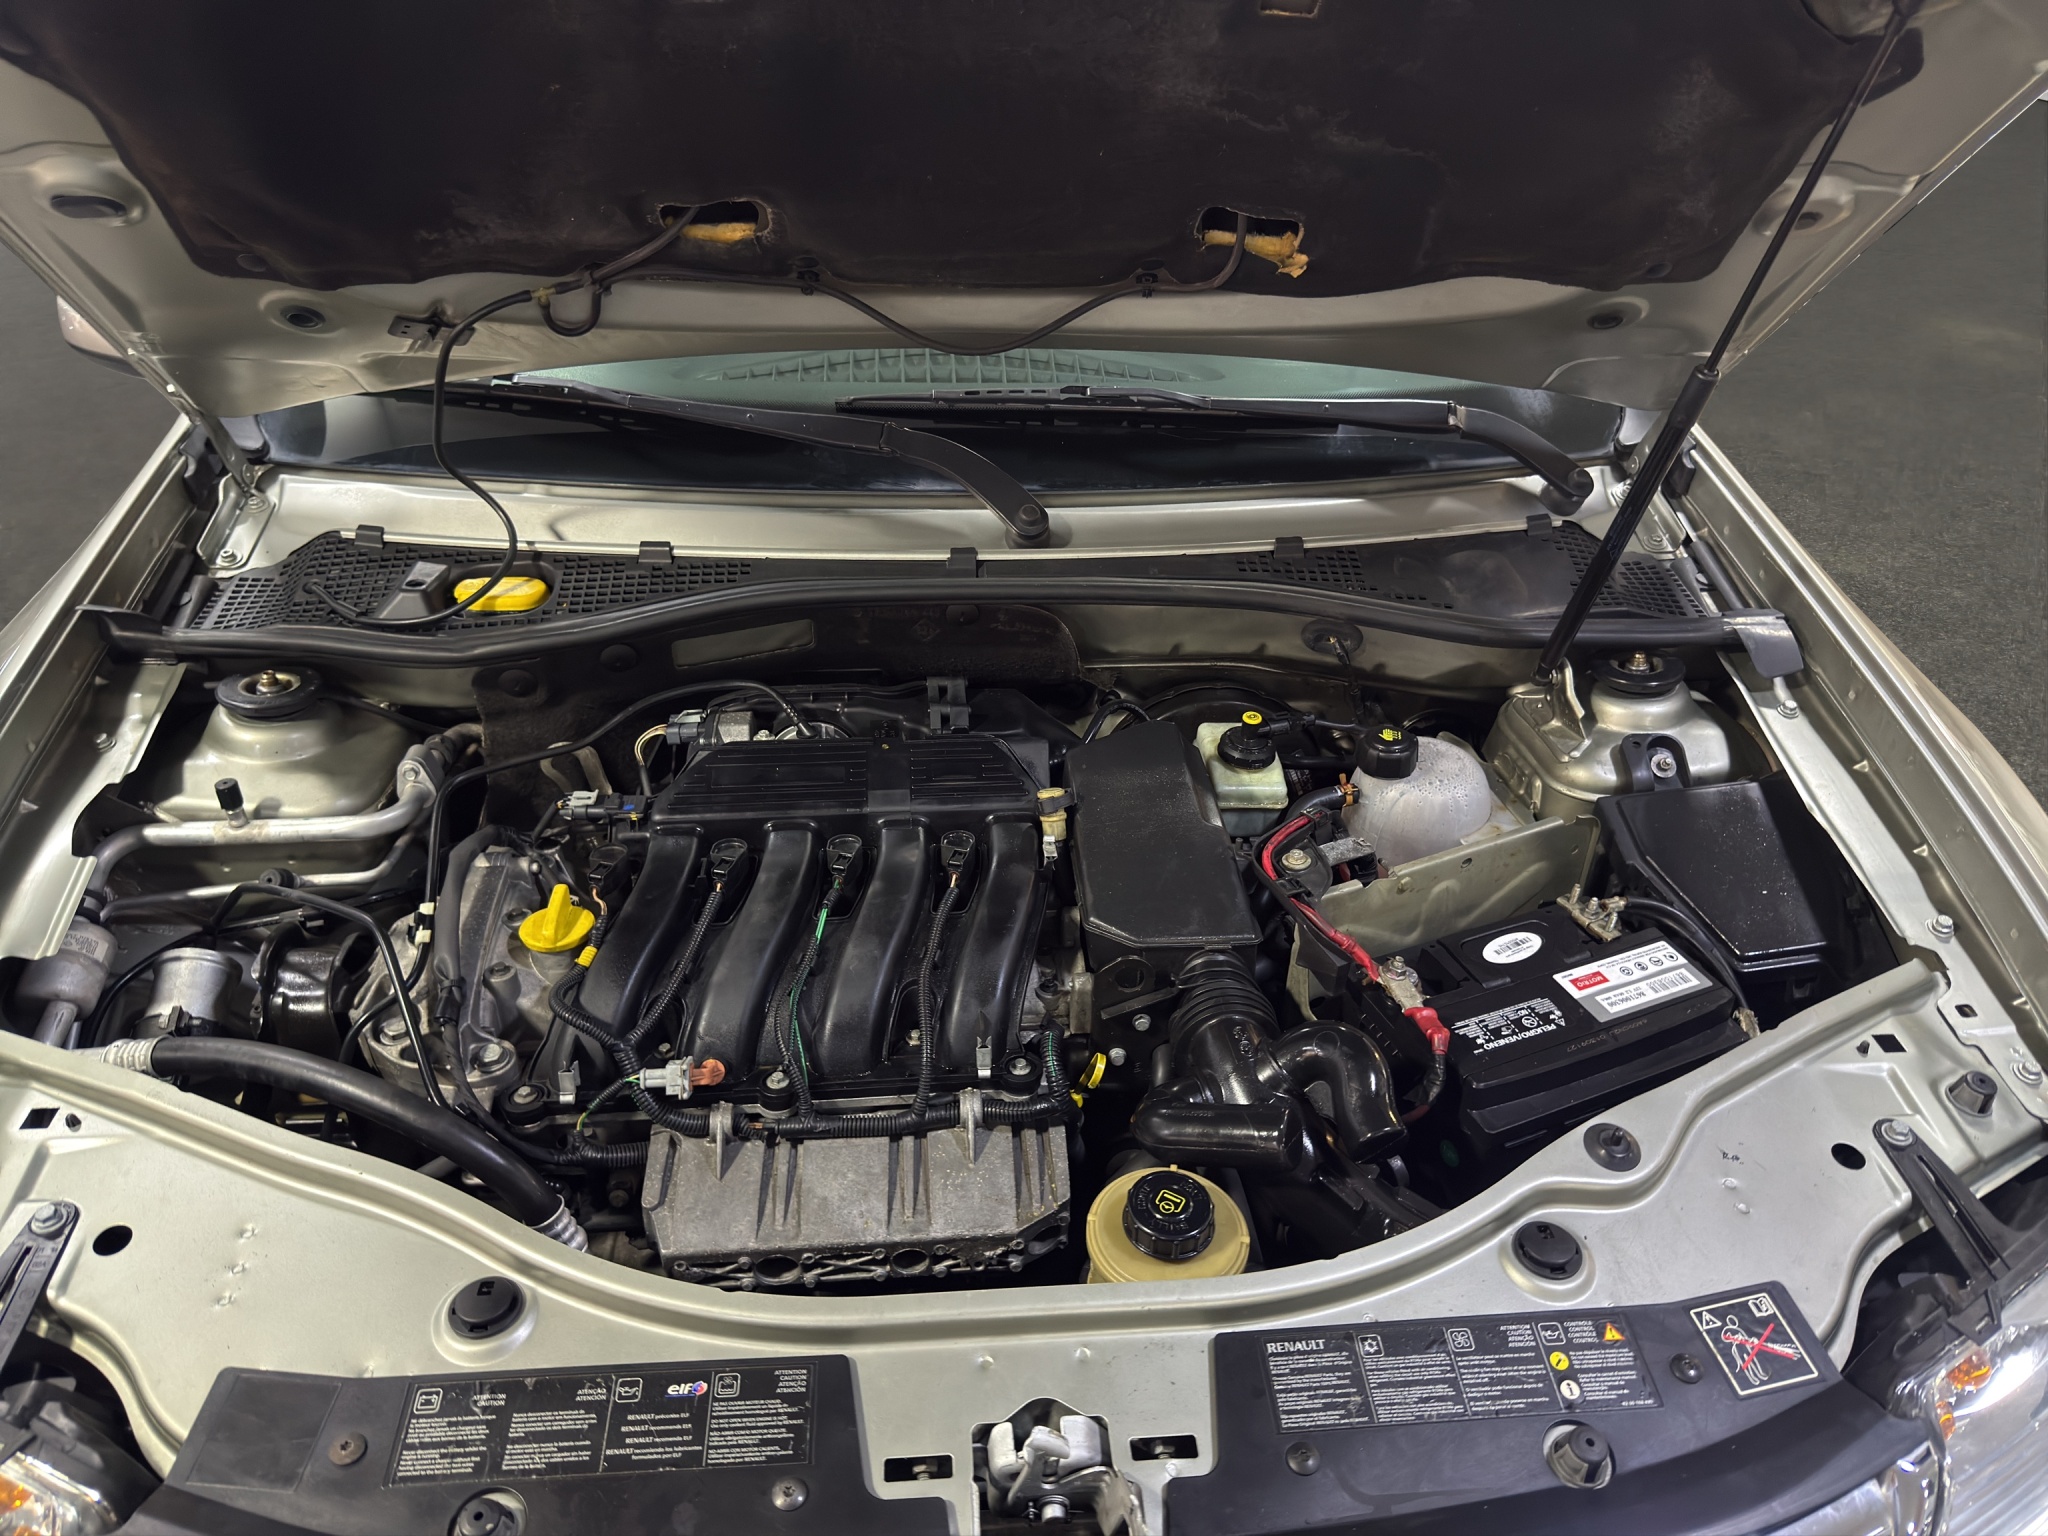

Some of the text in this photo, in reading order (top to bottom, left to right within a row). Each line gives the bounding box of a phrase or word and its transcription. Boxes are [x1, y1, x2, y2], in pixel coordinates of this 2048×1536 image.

[1484, 1024, 1557, 1050] PELIGRO/VENENO
[1266, 1340, 1326, 1354] RENAULT
[667, 1383, 694, 1394] elf
[626, 1436, 653, 1444] RENAULT
